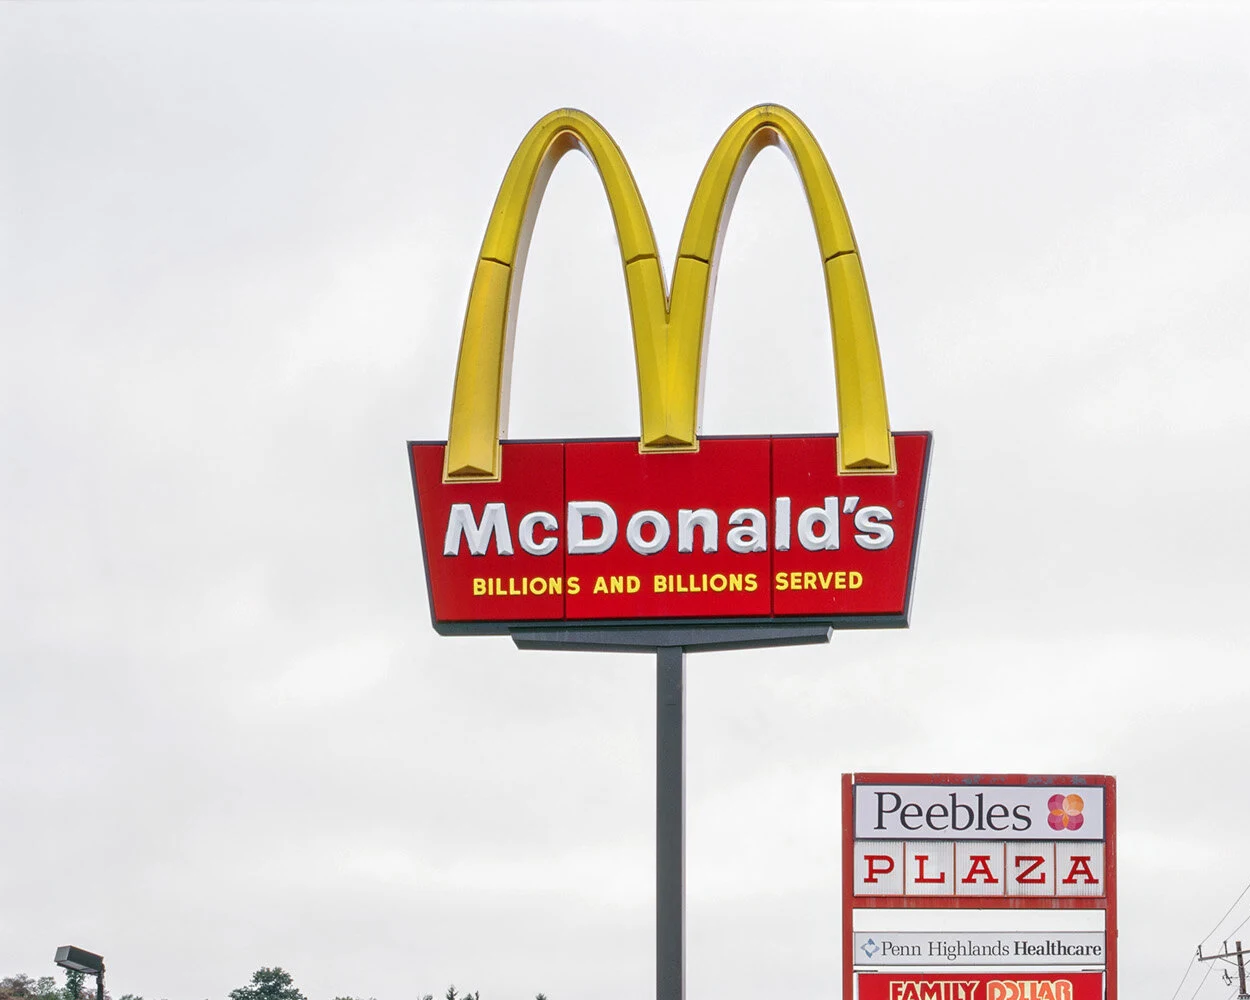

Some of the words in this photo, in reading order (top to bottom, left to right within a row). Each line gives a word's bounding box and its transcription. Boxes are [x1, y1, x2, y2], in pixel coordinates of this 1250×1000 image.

[443, 496, 895, 556] McDonald's
[473, 576, 580, 596] BILLIONS
[593, 575, 641, 594] AND
[654, 573, 758, 593] BILLIONS
[775, 571, 863, 591] SERVED
[873, 791, 1032, 832] Peebles
[863, 855, 1099, 884] PLAZA
[881, 941, 921, 956] Penn
[928, 940, 1009, 961] Highlands
[1013, 940, 1102, 956] Healthcare
